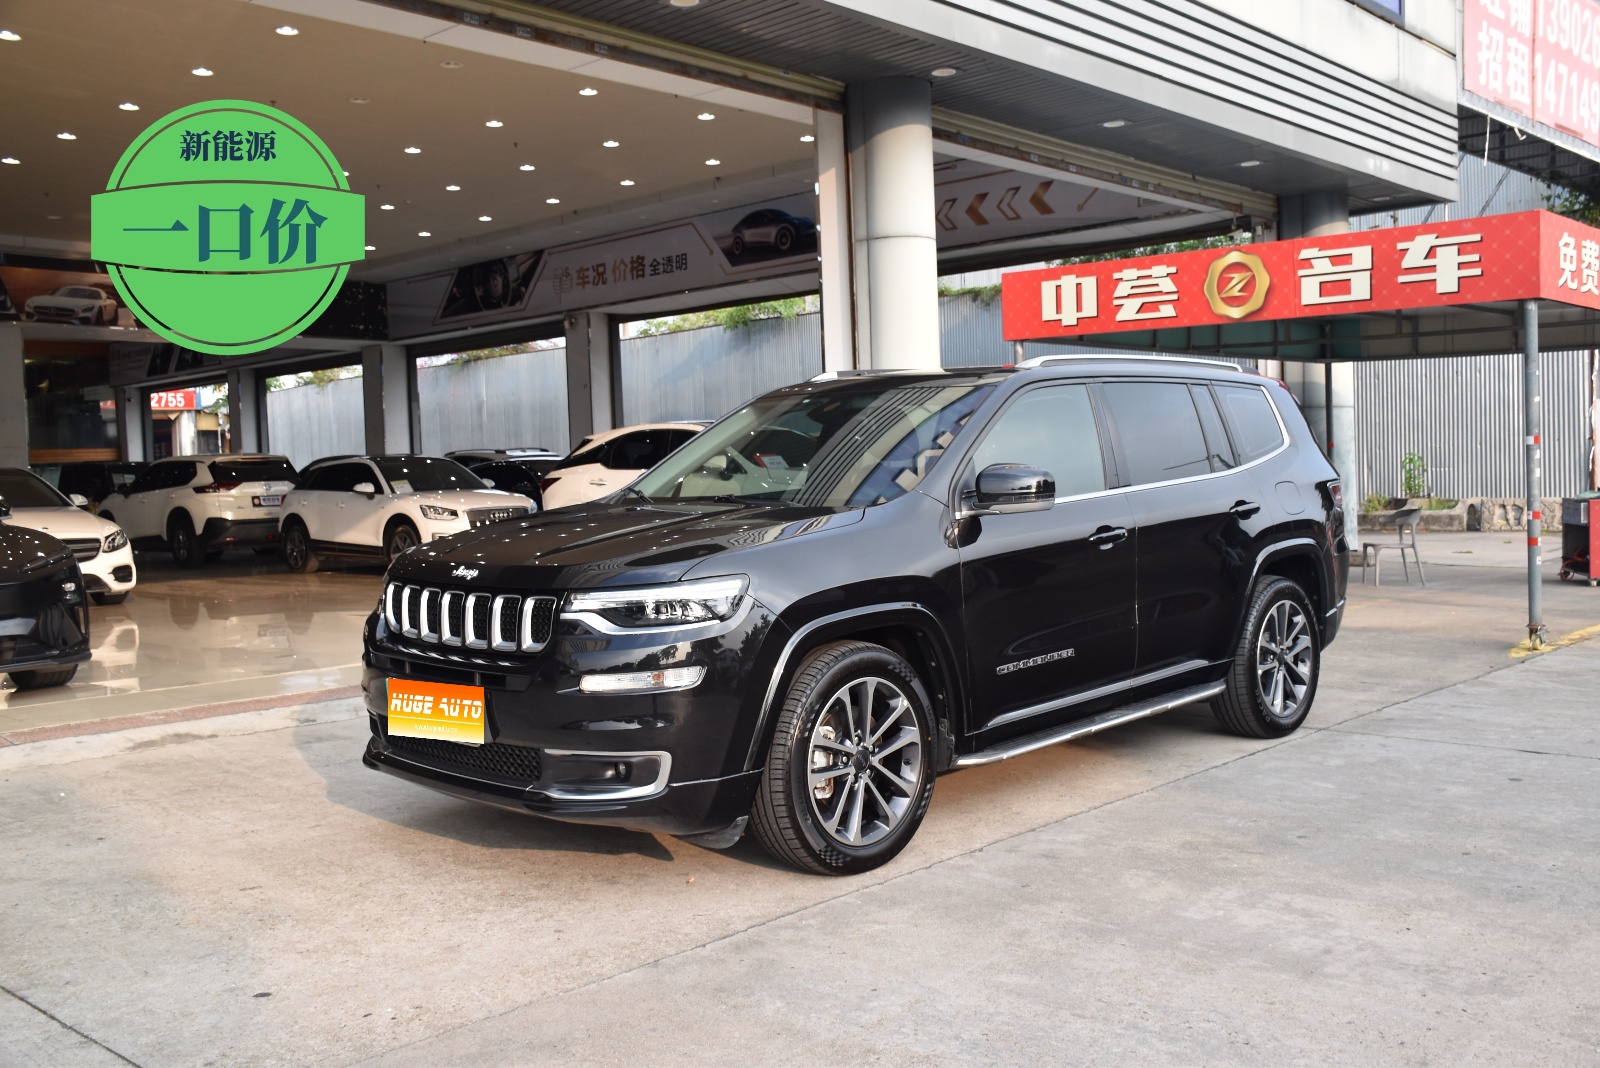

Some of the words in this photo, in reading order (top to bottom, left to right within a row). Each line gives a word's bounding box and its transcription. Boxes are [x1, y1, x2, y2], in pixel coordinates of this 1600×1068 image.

[1477, 20, 1530, 105] 招租
[1534, 52, 1600, 134] 147149
[575, 262, 609, 290] 车况
[611, 254, 647, 284] 价格
[648, 252, 689, 278] 全透明
[1040, 264, 1179, 327] 中荟
[1297, 233, 1483, 306] 名车
[1557, 231, 1600, 296] 免费
[150, 392, 185, 408] 2755
